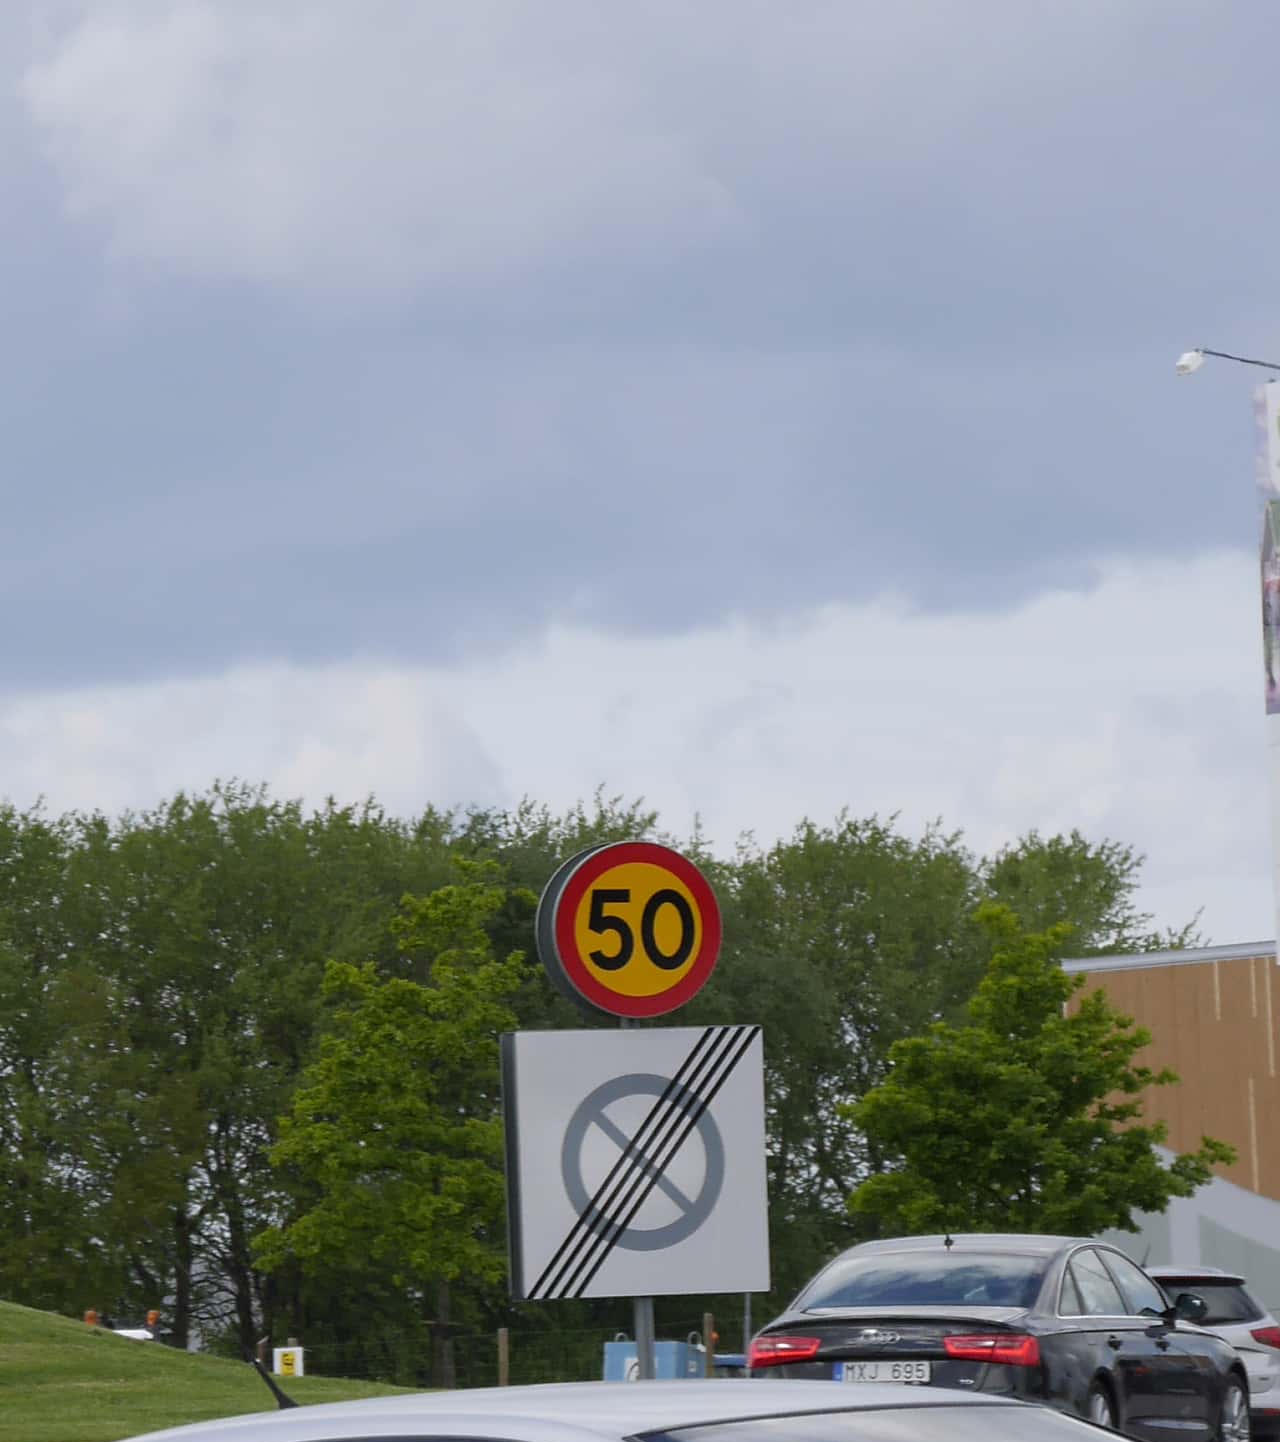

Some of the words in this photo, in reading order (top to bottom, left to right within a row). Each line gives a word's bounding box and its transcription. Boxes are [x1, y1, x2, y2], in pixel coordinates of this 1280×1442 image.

[589, 888, 696, 971] 50
[845, 1363, 879, 1380] MXJ
[891, 1363, 926, 1380] 695
